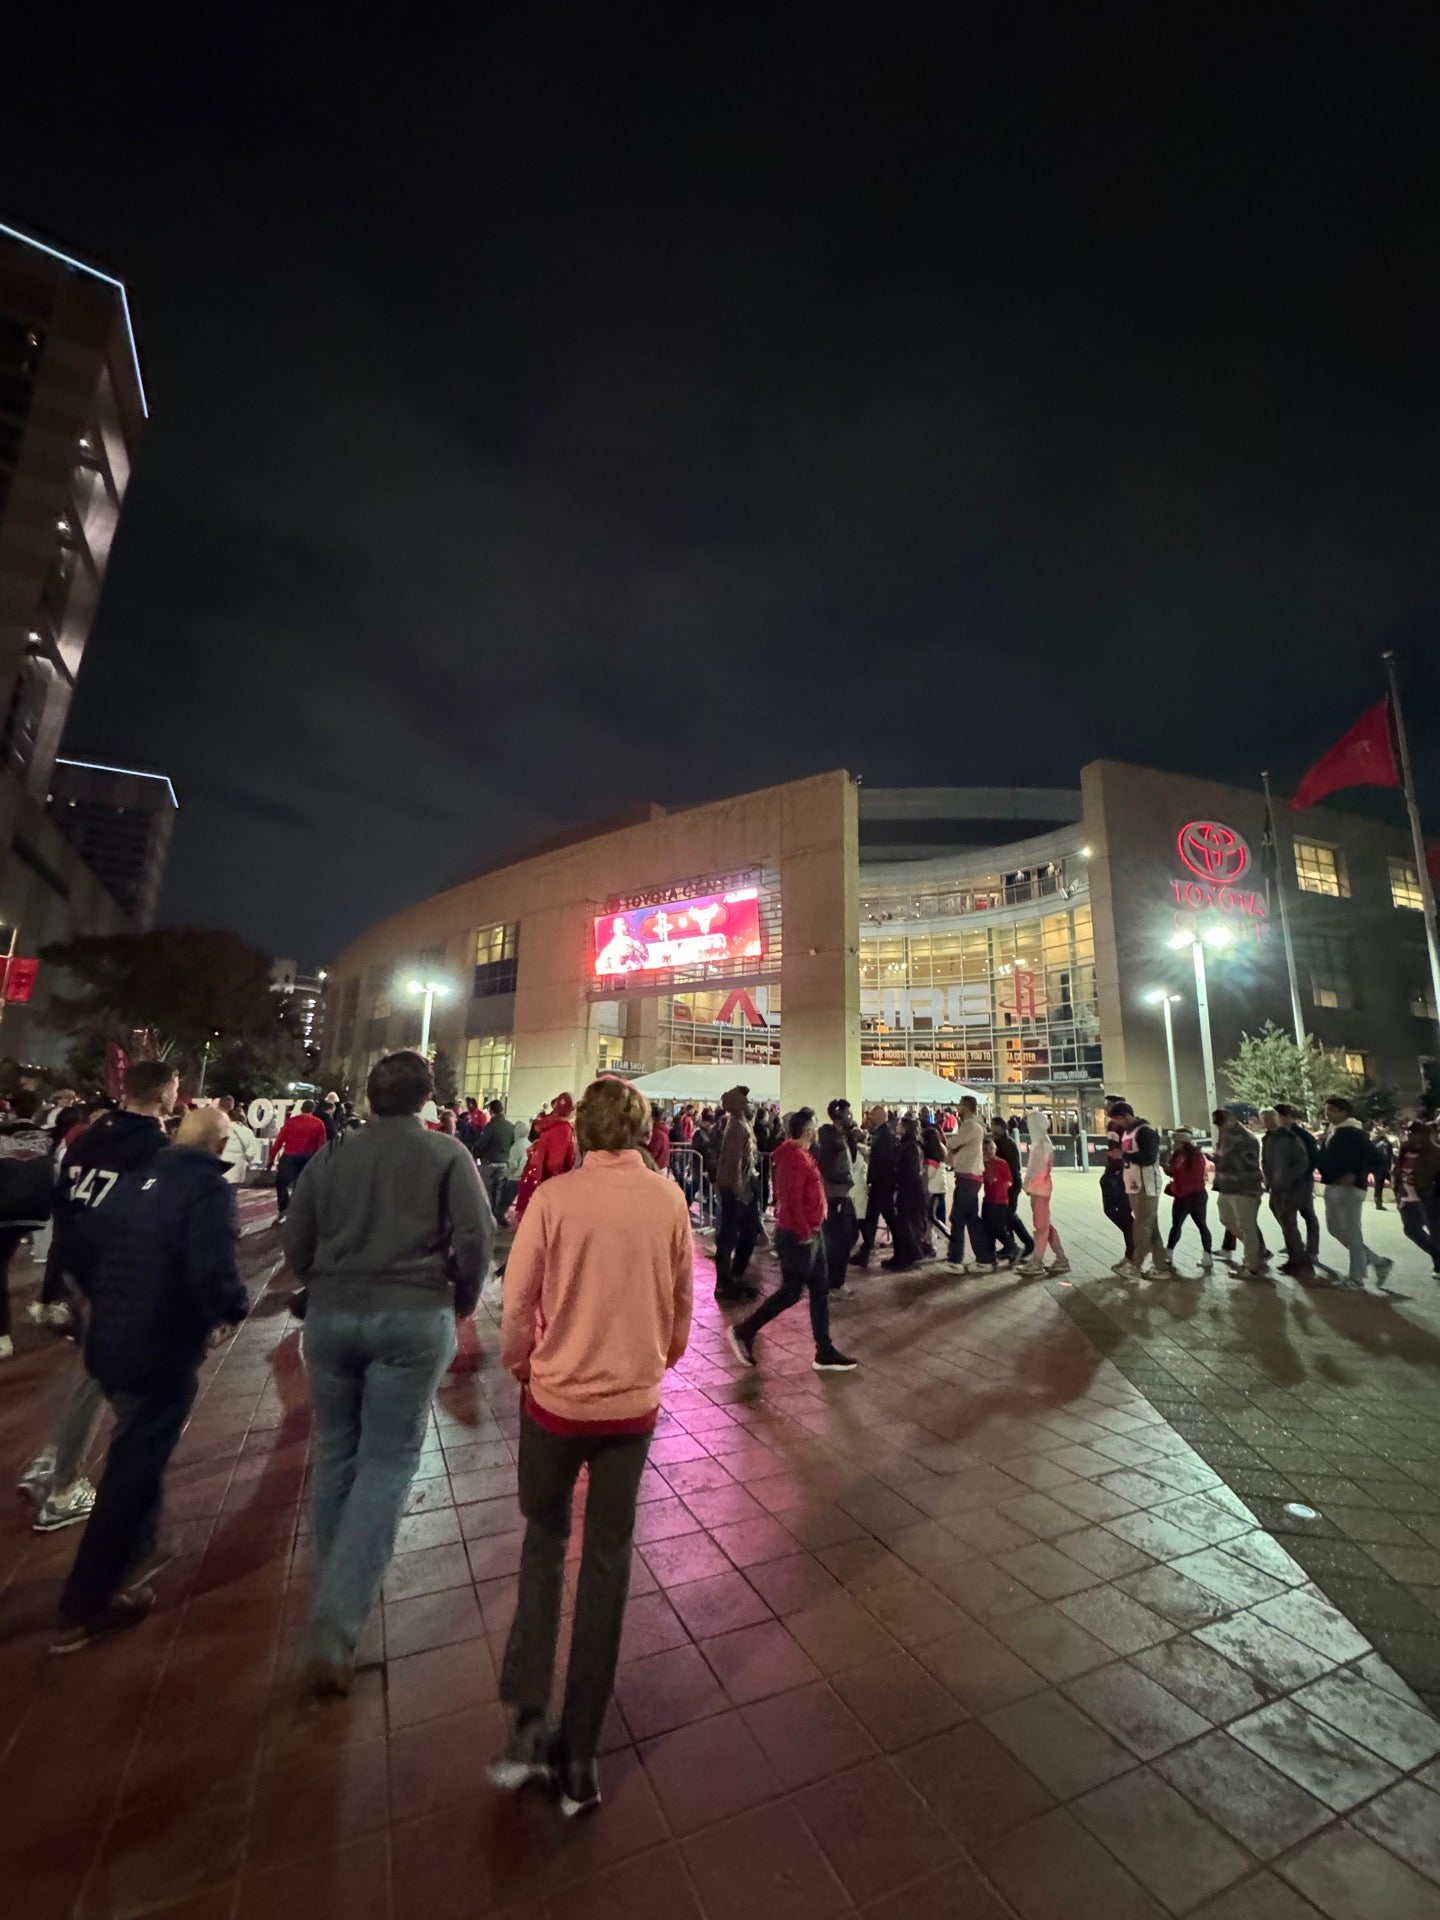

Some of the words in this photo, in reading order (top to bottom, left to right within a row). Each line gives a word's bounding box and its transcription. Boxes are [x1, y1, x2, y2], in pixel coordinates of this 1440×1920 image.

[624, 887, 678, 909] TOYOTA
[683, 872, 752, 898] CENTER
[885, 1049, 908, 1060] HOUSTO
[914, 1050, 940, 1061] ROCKES
[940, 1050, 969, 1061] WELCOME
[970, 1050, 983, 1061] YOU
[983, 1051, 991, 1061] TO
